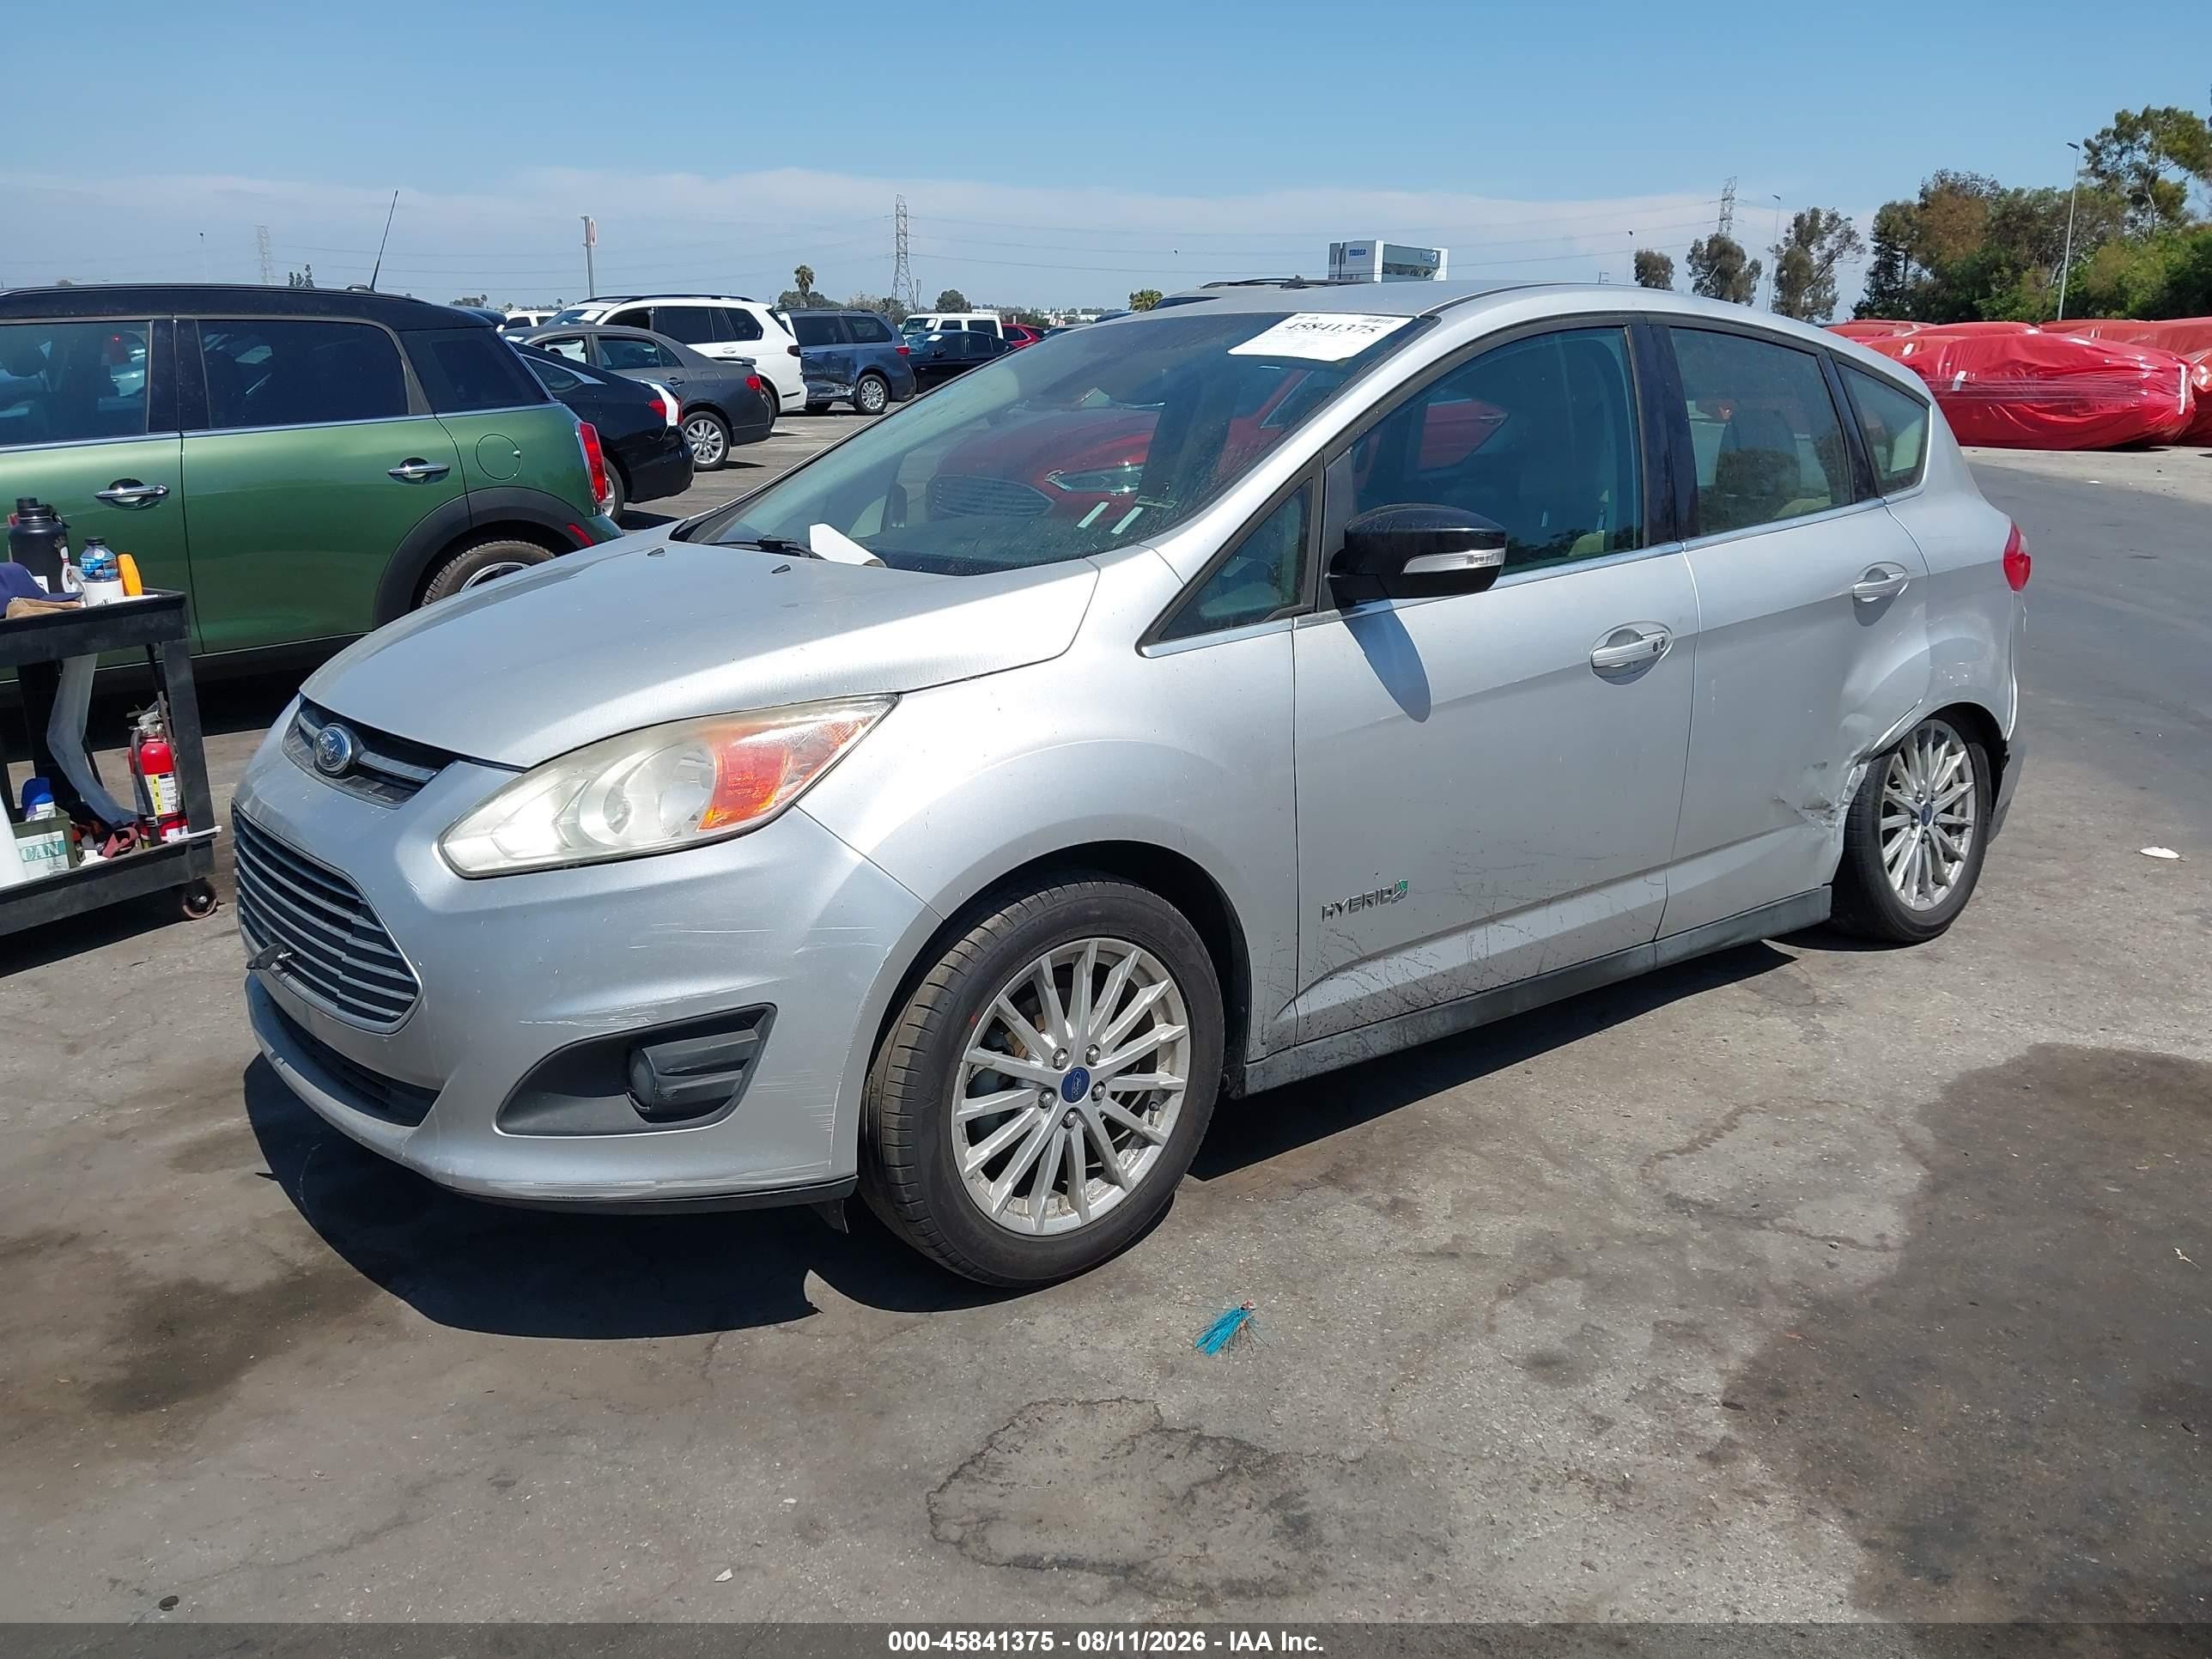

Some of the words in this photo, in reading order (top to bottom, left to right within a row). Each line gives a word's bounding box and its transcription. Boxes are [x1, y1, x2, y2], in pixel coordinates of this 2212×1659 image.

[1285, 322, 1382, 334] 45841375
[317, 732, 337, 762] Ford
[21, 842, 60, 861] CAN
[1322, 885, 1394, 922] HYBRID
